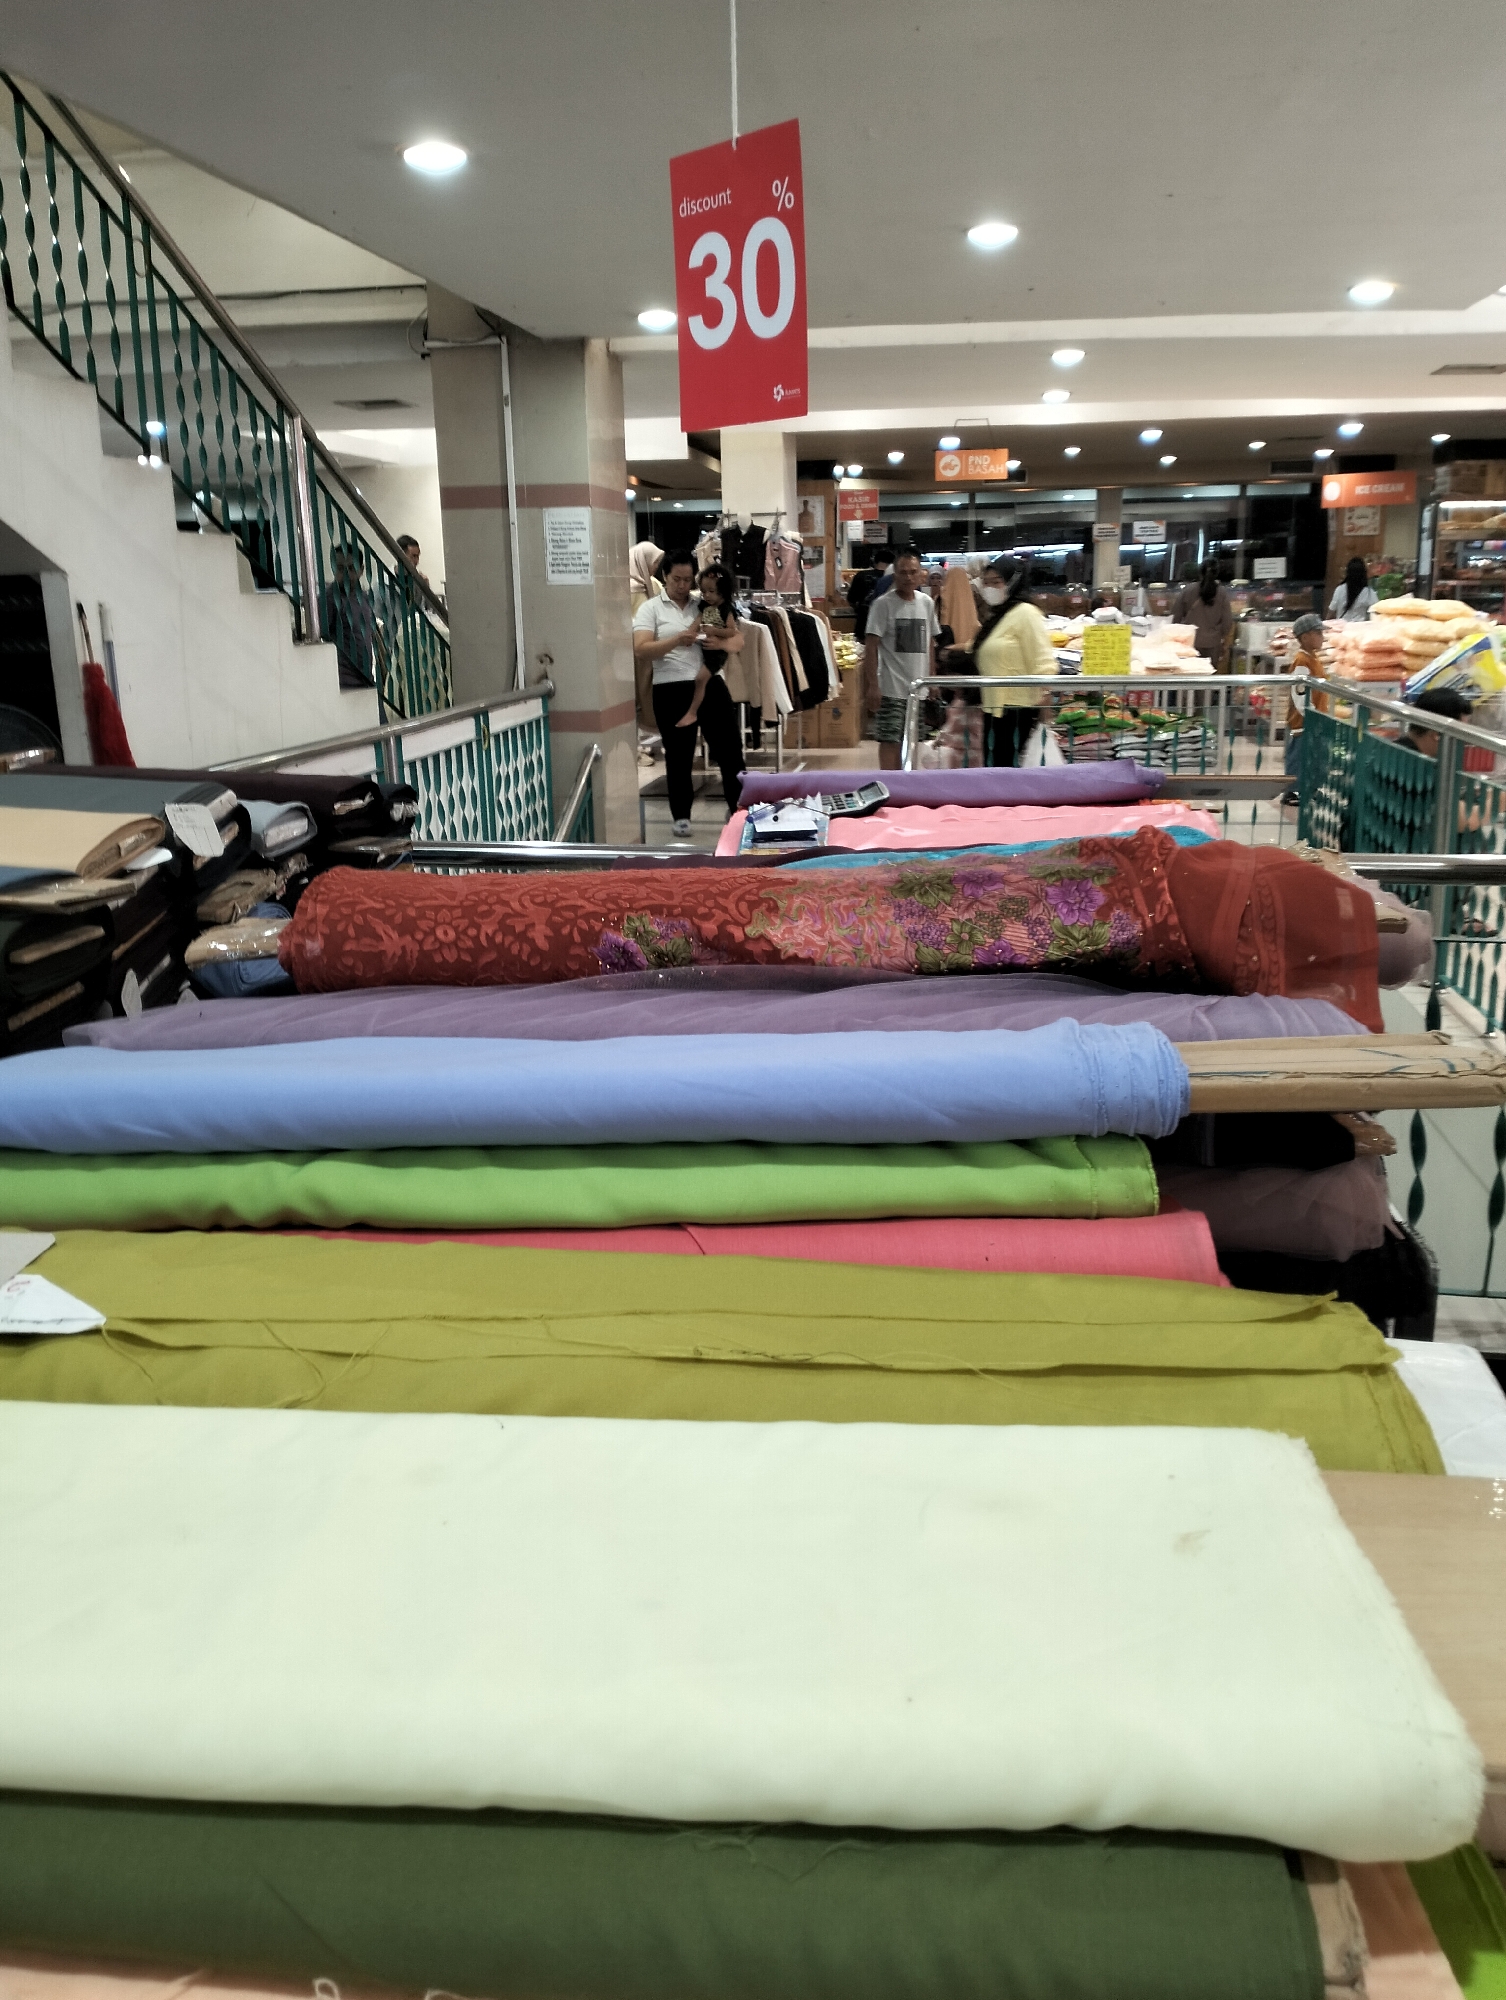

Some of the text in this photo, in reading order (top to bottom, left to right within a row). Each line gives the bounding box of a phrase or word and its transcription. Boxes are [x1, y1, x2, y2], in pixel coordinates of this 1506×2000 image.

[679, 177, 795, 218] discount %
[688, 217, 796, 350] 30
[968, 455, 991, 465] PND
[968, 464, 1005, 475] BASAH
